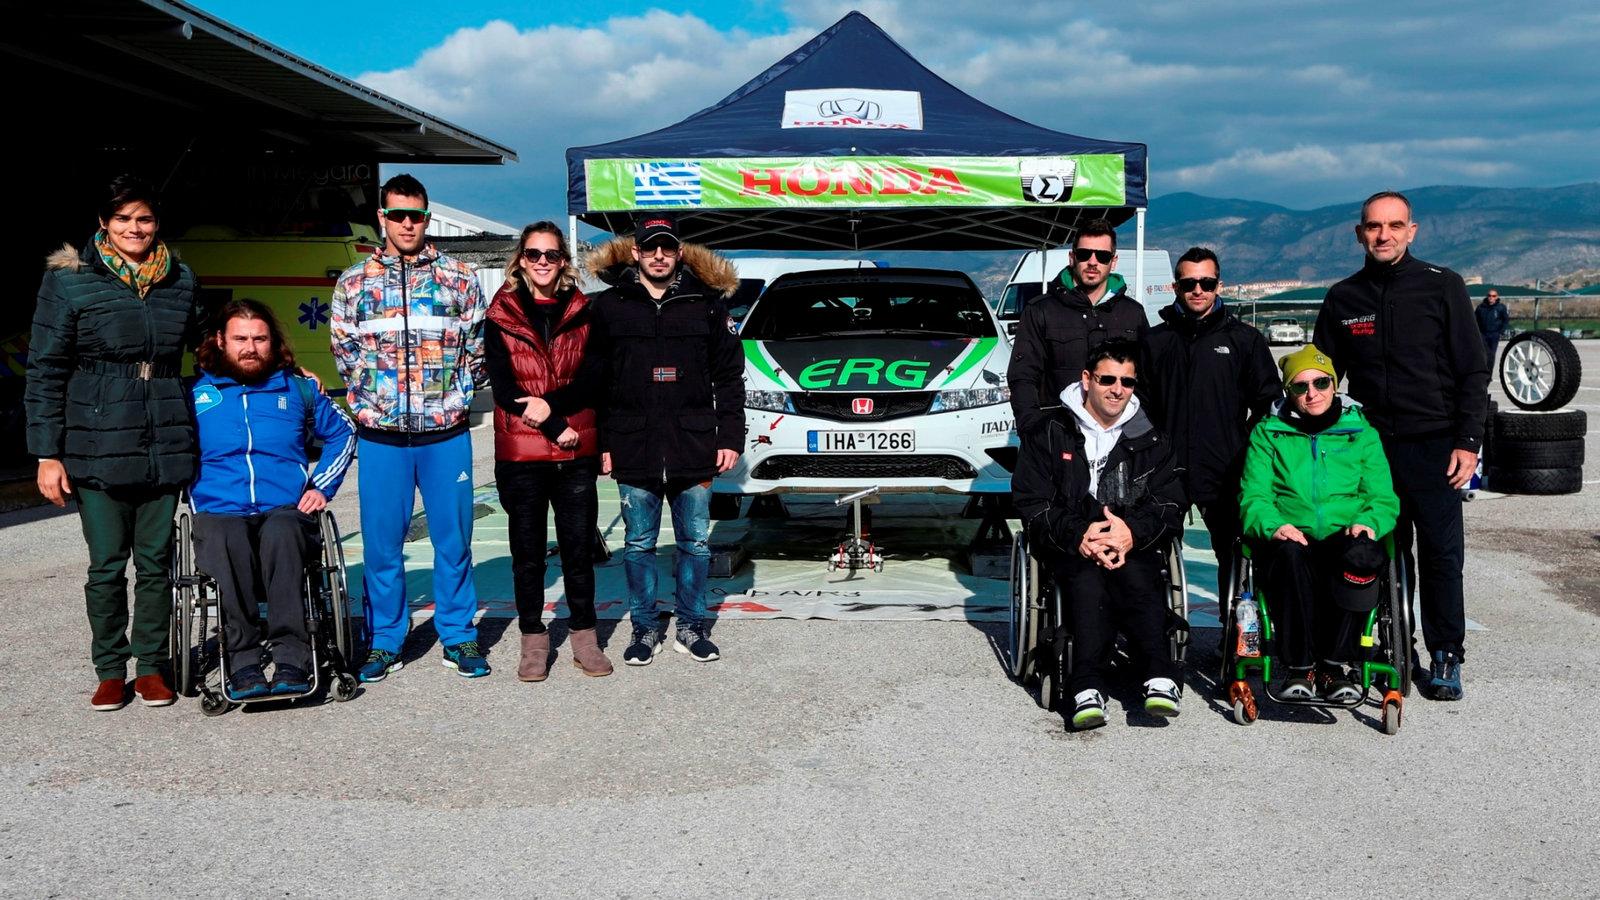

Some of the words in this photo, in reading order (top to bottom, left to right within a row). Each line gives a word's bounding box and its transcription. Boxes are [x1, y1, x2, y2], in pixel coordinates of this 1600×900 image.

[738, 167, 970, 196] HONDA
[799, 358, 931, 389] ERG
[826, 433, 911, 450] IHA-1266
